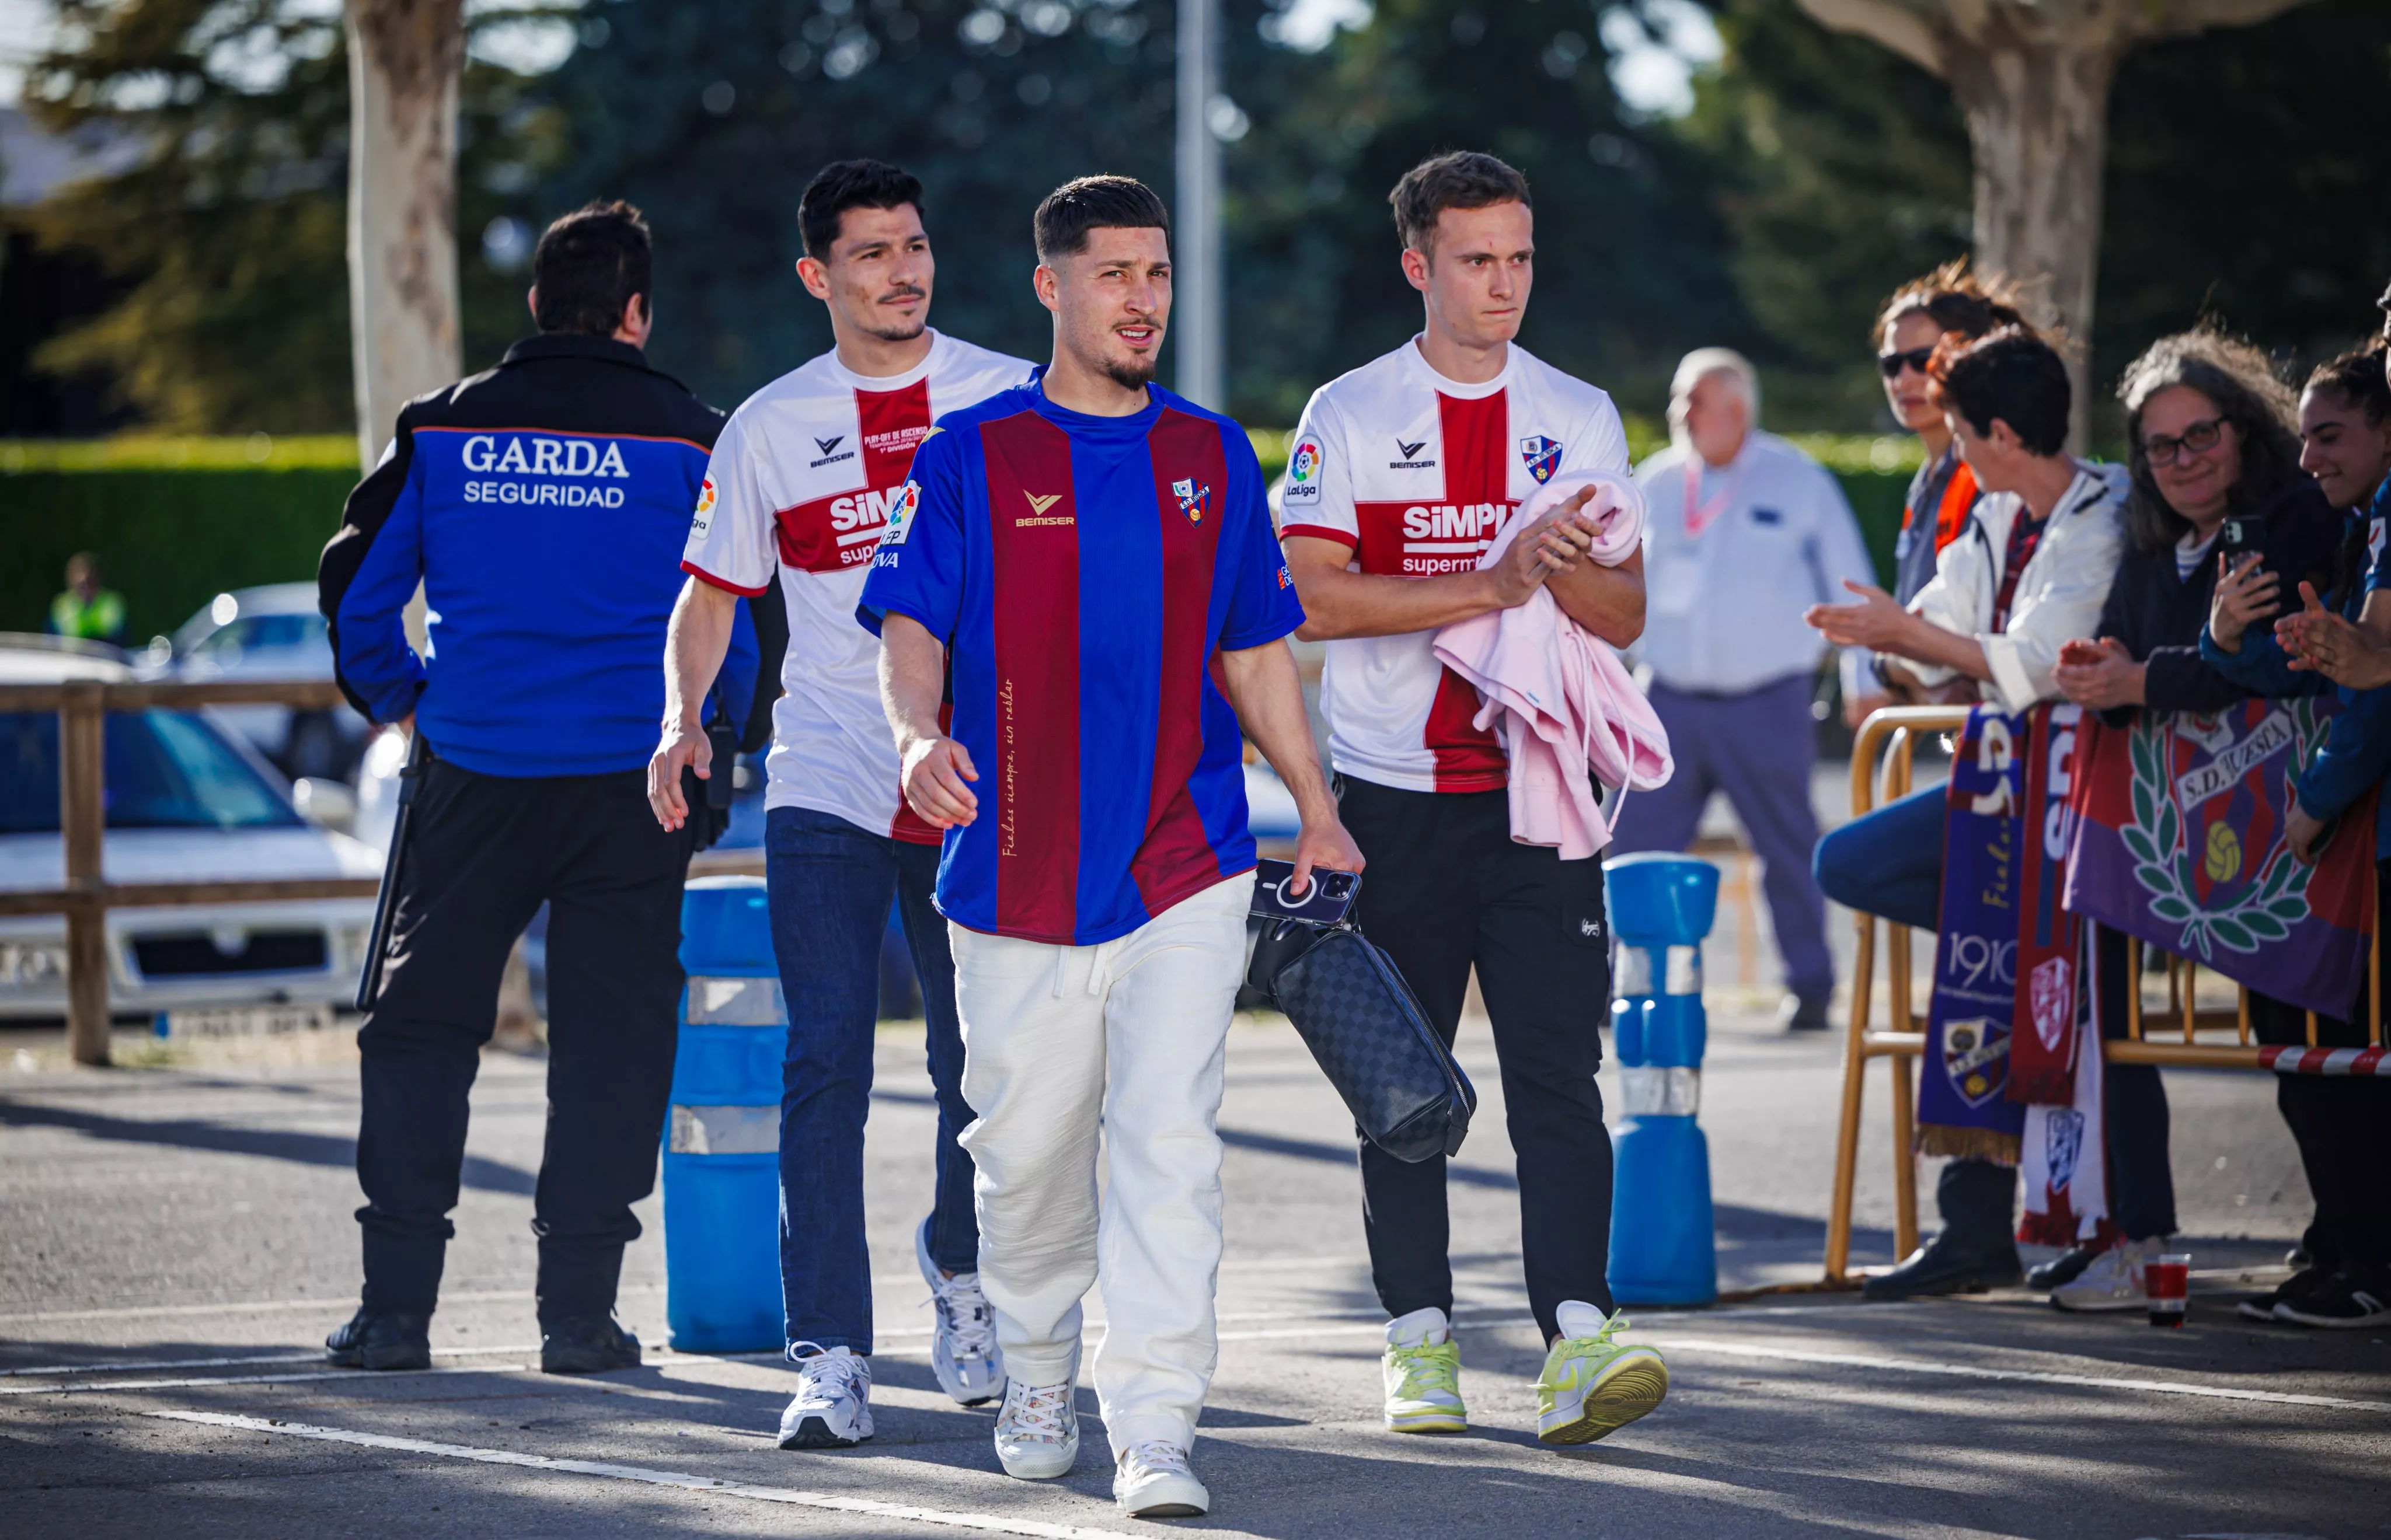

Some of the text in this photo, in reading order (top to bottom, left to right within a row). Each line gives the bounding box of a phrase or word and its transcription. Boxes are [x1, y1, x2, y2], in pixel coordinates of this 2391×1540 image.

[864, 425, 928, 445] PLAY-OFF DE ASCENSO
[462, 435, 630, 477] GARDA
[810, 451, 855, 468] BEMISER
[1390, 460, 1435, 469] BEMISER
[463, 480, 625, 508] SEGURIDAD
[1287, 484, 1316, 497] LaLiga
[829, 485, 902, 531] SiM
[1016, 517, 1075, 527] BEMISER
[870, 552, 898, 569] BVA
[1403, 556, 1483, 576] superm
[999, 679, 1018, 857] Fieles siempre, sin reblar
